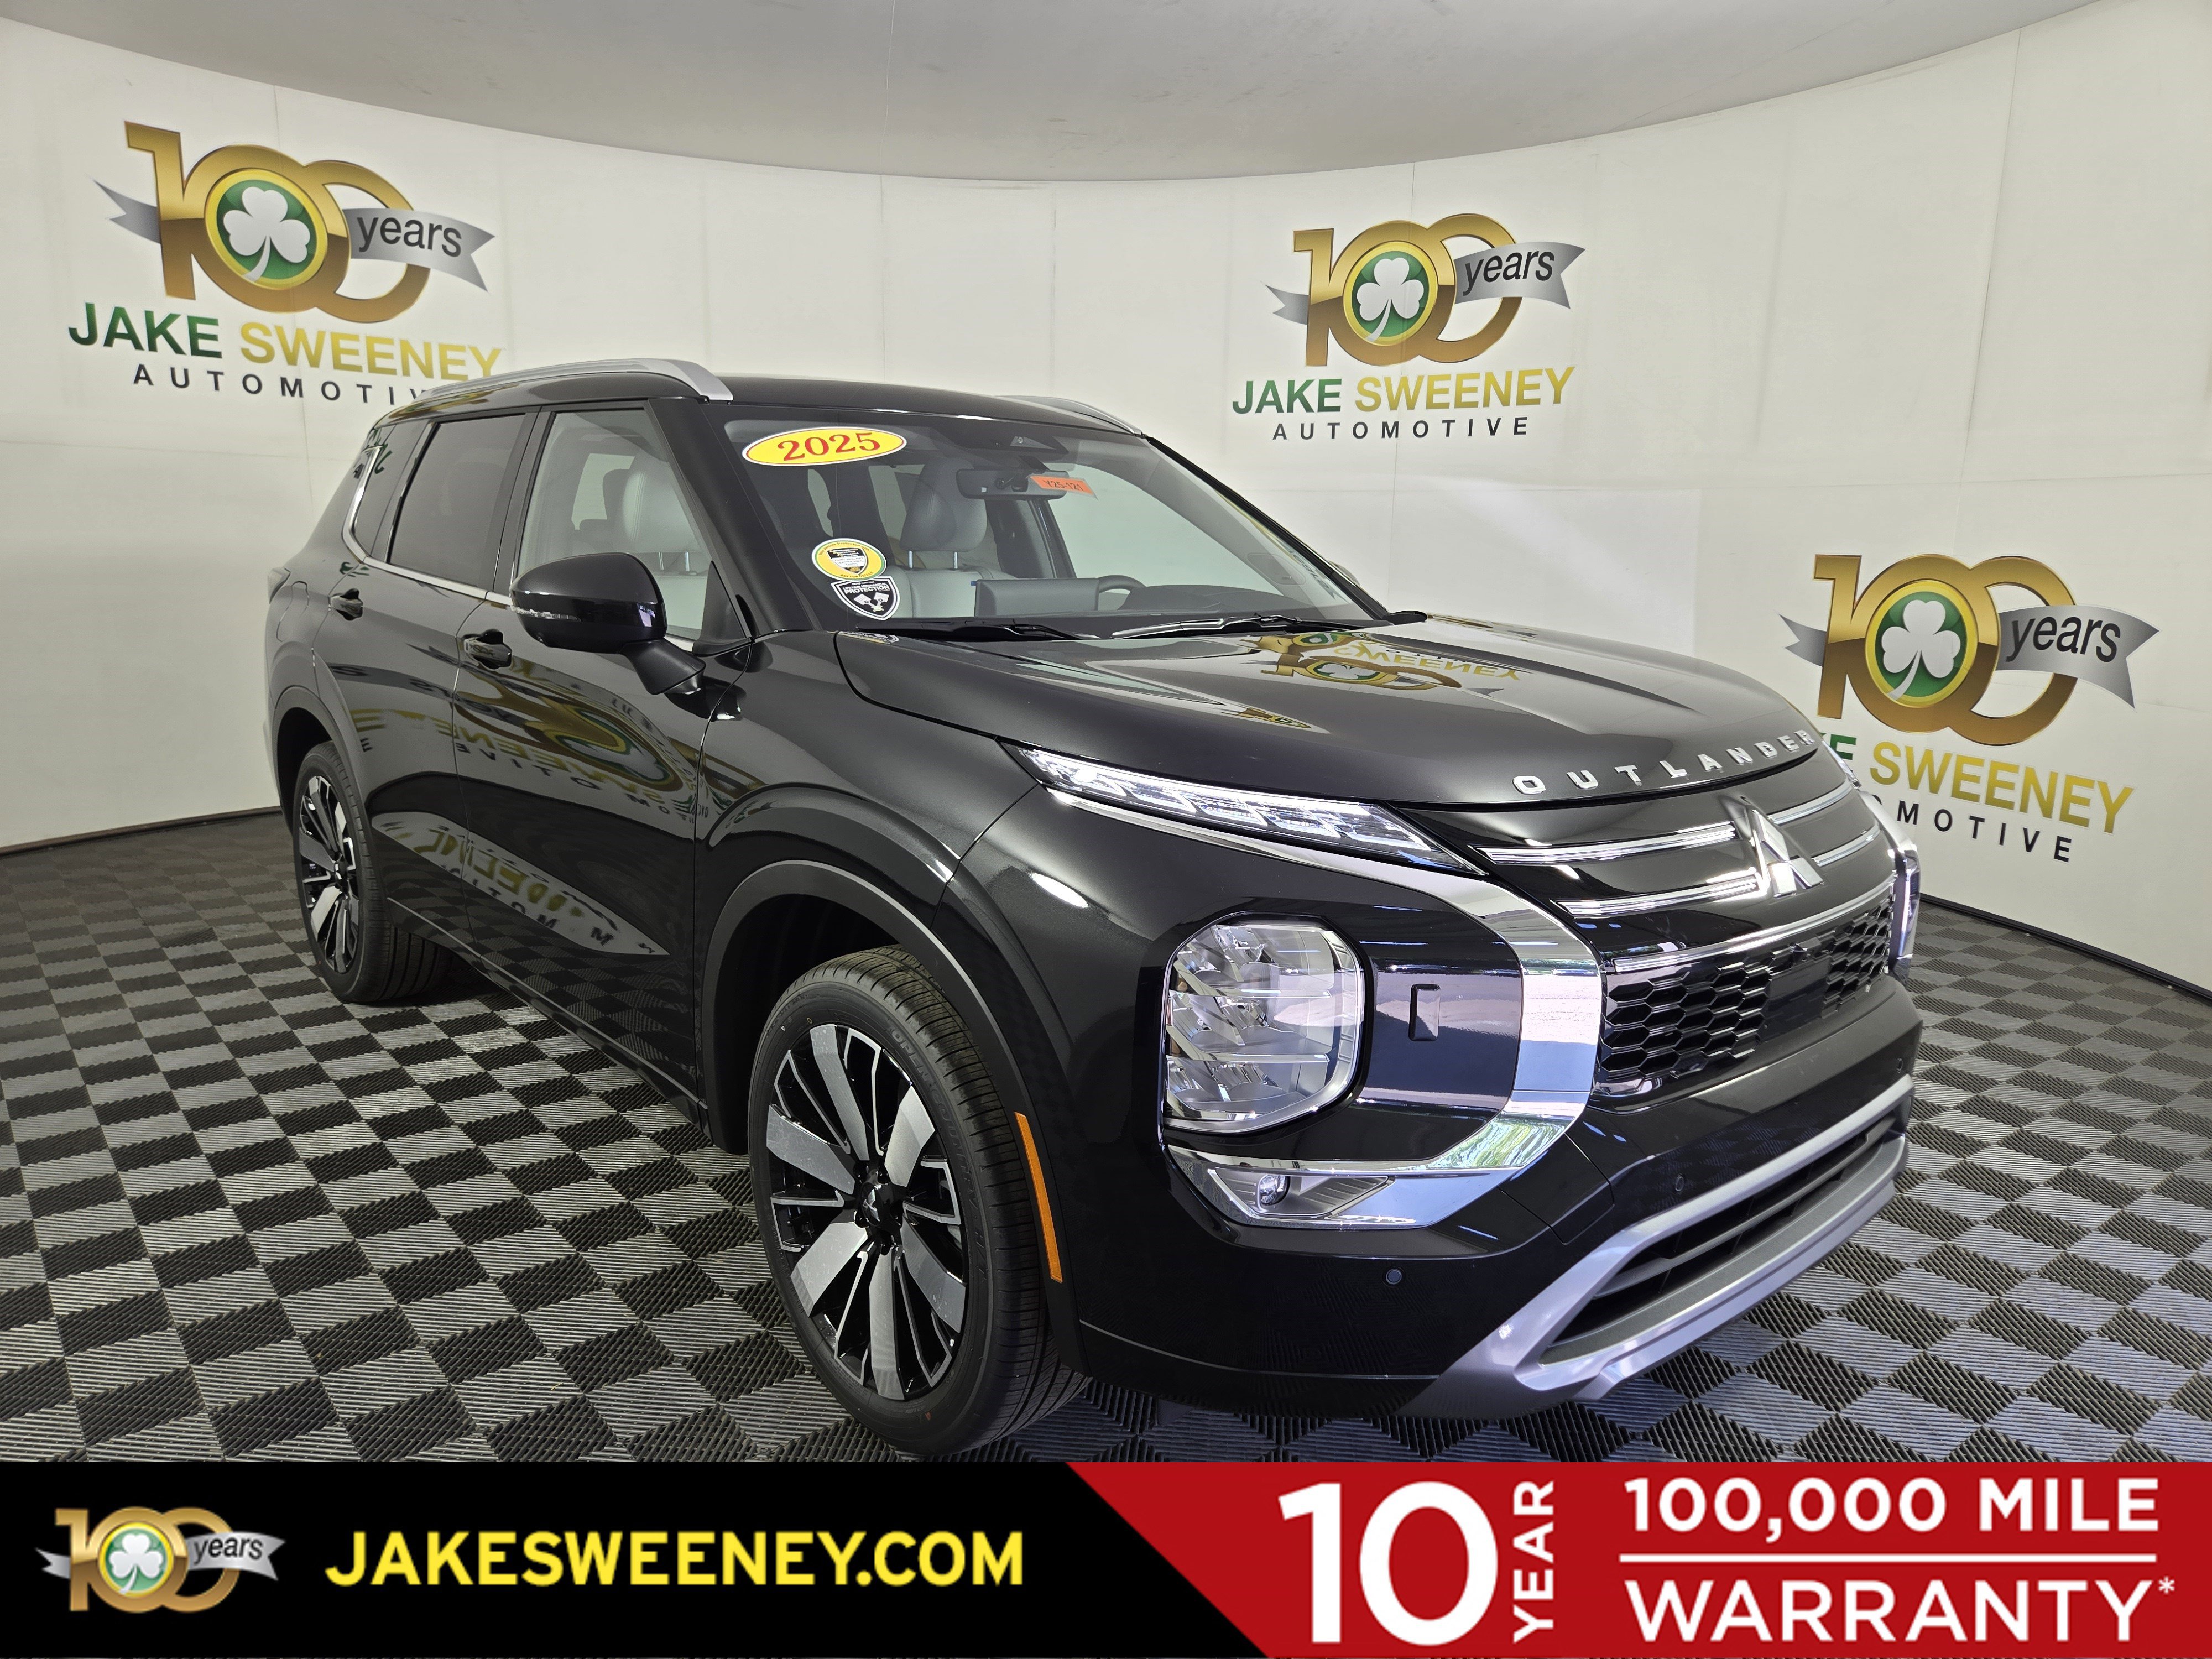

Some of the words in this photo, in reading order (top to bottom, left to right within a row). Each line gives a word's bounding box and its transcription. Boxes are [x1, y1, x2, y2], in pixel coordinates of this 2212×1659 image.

[356, 214, 463, 257] years
[1462, 251, 1554, 296] years
[69, 302, 222, 359] JAKE
[241, 321, 502, 383] SWEENEY
[133, 363, 427, 406] AUTOMOTI
[1232, 378, 1342, 414] JAKE
[1355, 366, 1575, 412] SWEENEY
[778, 432, 880, 461] 2025
[1272, 416, 1527, 440] AUTOMOTIVE
[844, 585, 890, 594] PROTECTION
[2006, 615, 2121, 662] years
[1512, 729, 1815, 795] OUTLANDER
[1870, 741, 2135, 834] SWEENEY
[1871, 794, 2073, 863] MOTIVE
